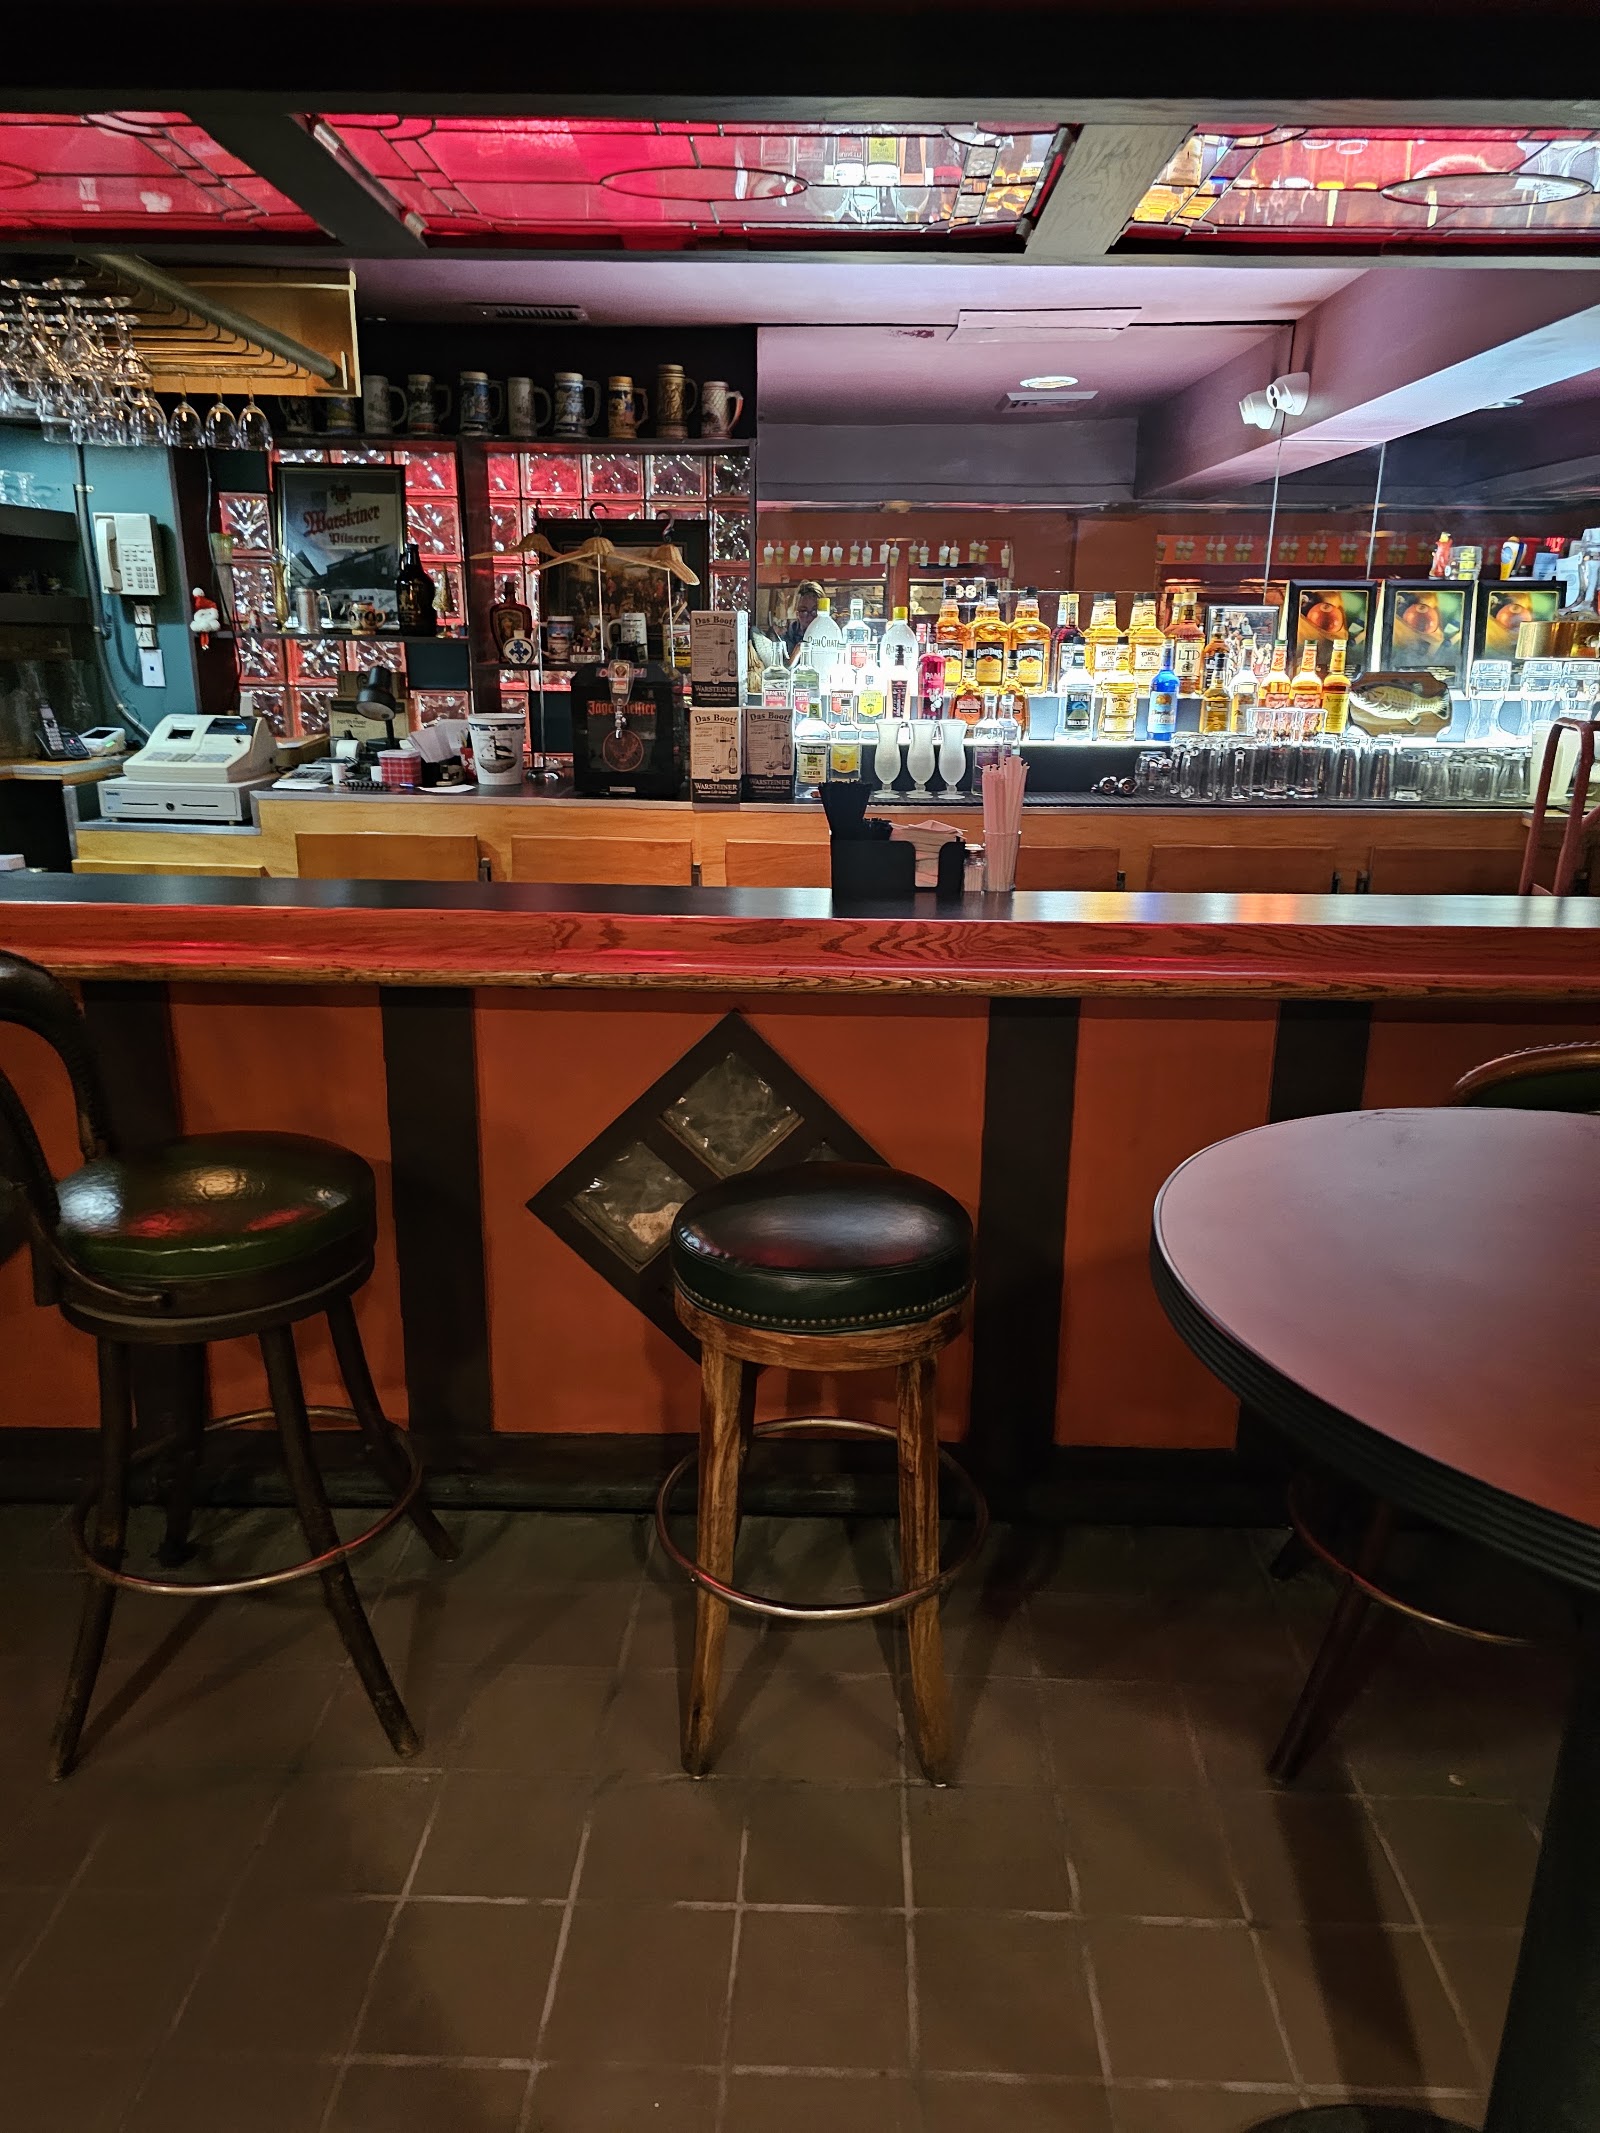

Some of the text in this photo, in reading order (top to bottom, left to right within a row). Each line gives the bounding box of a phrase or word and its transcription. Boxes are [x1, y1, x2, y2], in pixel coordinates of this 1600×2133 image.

[303, 505, 380, 537] Warsteiner
[328, 532, 381, 545] Pilsener
[694, 615, 736, 627] Das Boot!
[1178, 650, 1201, 661] LTD
[694, 685, 737, 693] WARSTEINER
[694, 713, 738, 725] Das Boot!
[749, 711, 792, 722] Das Boot!
[694, 782, 738, 791] WARSTEINER
[749, 778, 791, 786] WARSTEINER
